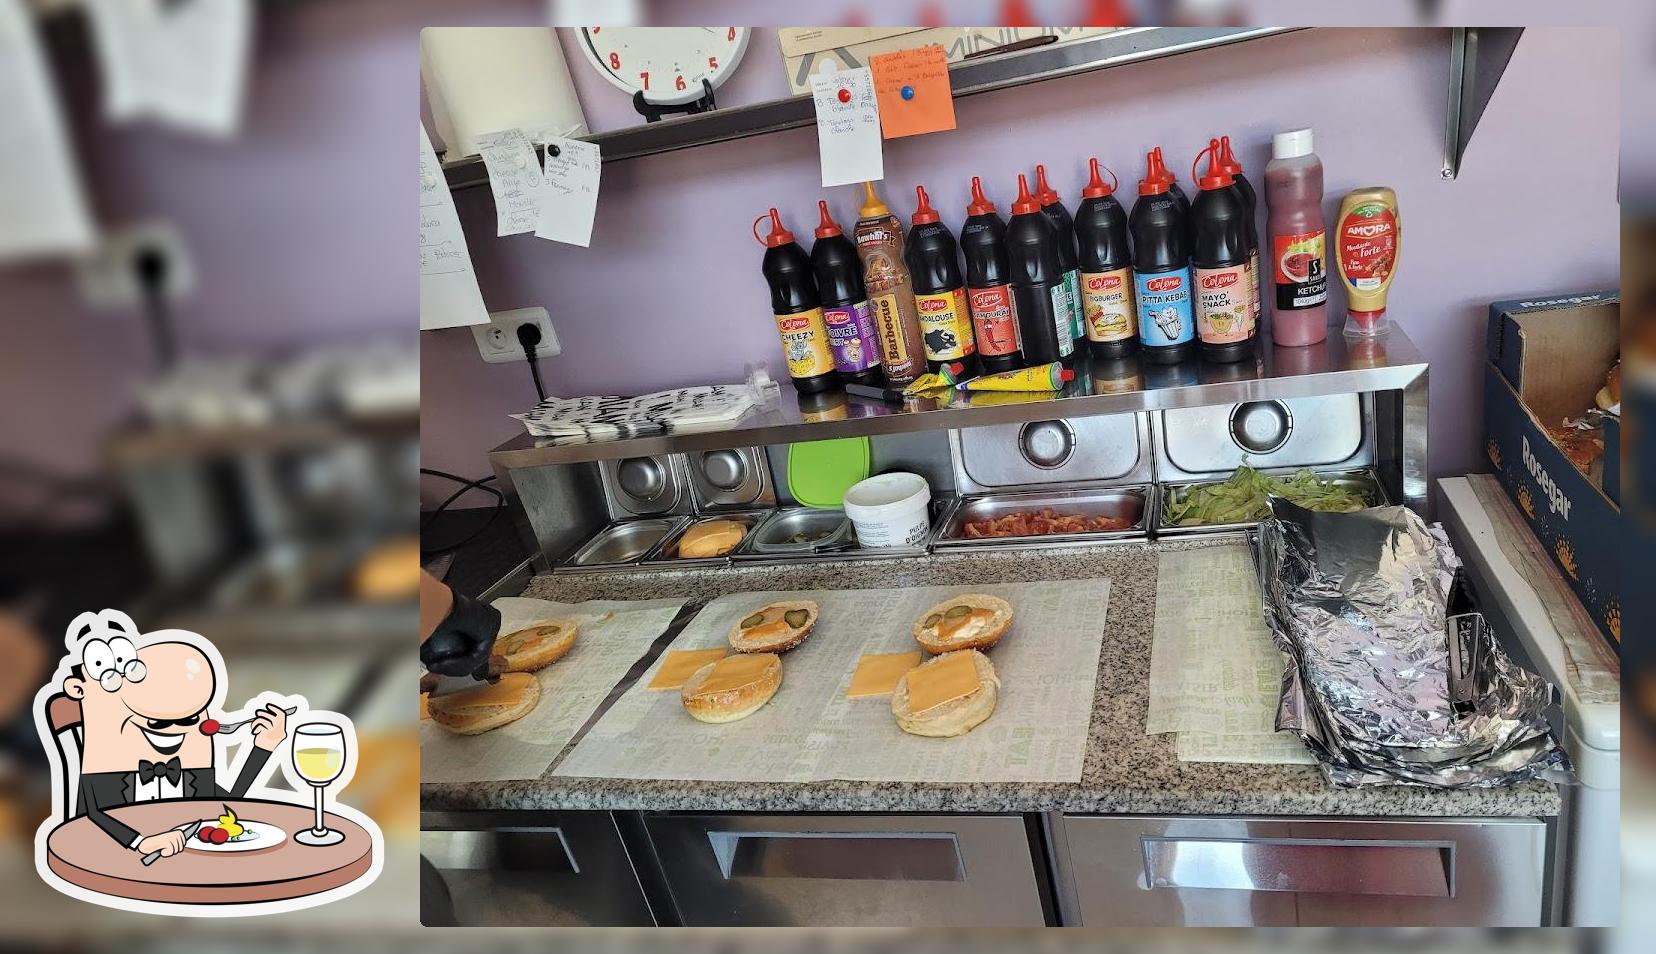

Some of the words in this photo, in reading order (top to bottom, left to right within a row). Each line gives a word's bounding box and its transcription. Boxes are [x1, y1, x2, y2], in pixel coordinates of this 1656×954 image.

[609, 52, 621, 70] 8
[708, 56, 719, 69] 5
[640, 72, 649, 90] 7
[675, 74, 687, 91] 6
[1347, 223, 1391, 236] AMORA
[1089, 276, 1121, 289] Colona
[1148, 277, 1181, 290] Colona
[1202, 274, 1238, 288] Colona
[1142, 296, 1162, 304] PITTA
[1202, 299, 1231, 308] SNACK
[1520, 294, 1600, 307] Rosegar
[828, 326, 857, 337] OIVRE
[881, 299, 900, 361] Barbecue
[1522, 435, 1572, 522] Rosegar
